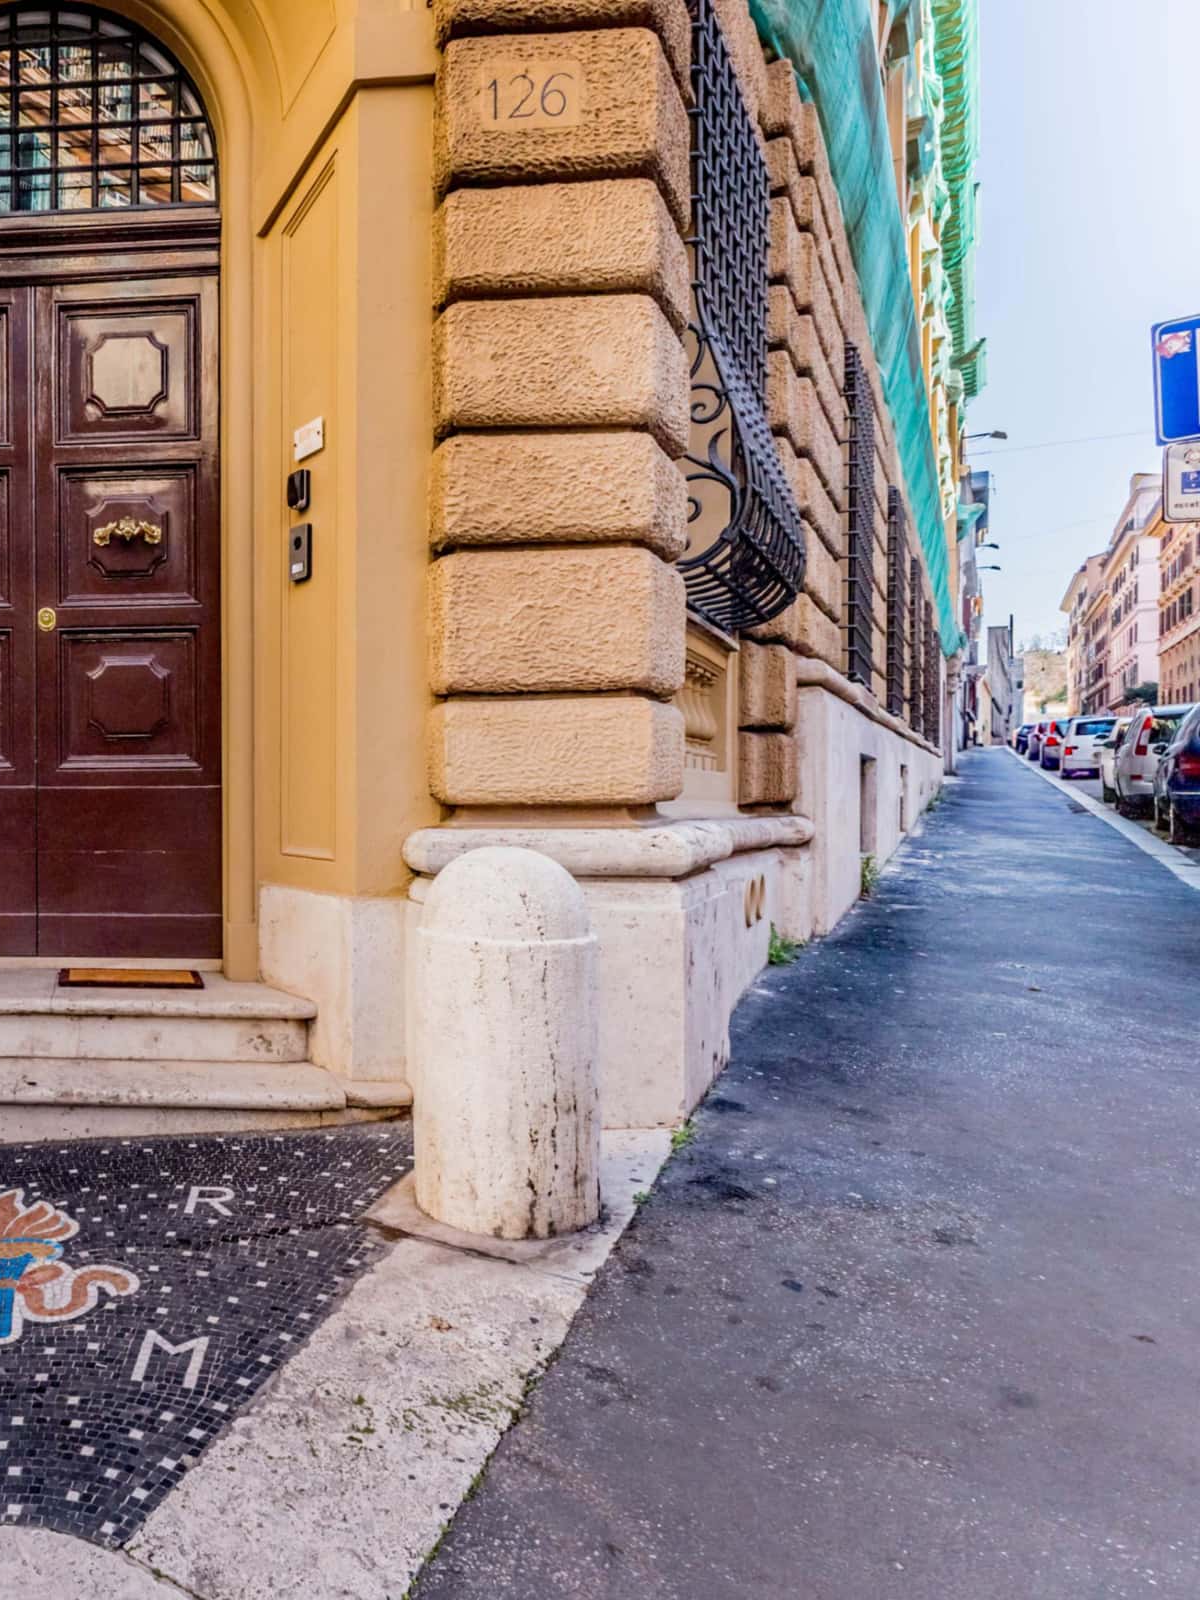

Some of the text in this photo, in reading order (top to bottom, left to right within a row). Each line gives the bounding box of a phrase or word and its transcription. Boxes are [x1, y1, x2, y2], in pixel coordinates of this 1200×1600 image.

[487, 72, 574, 120] 126
[184, 1186, 236, 1216] R
[131, 1328, 210, 1388] M
